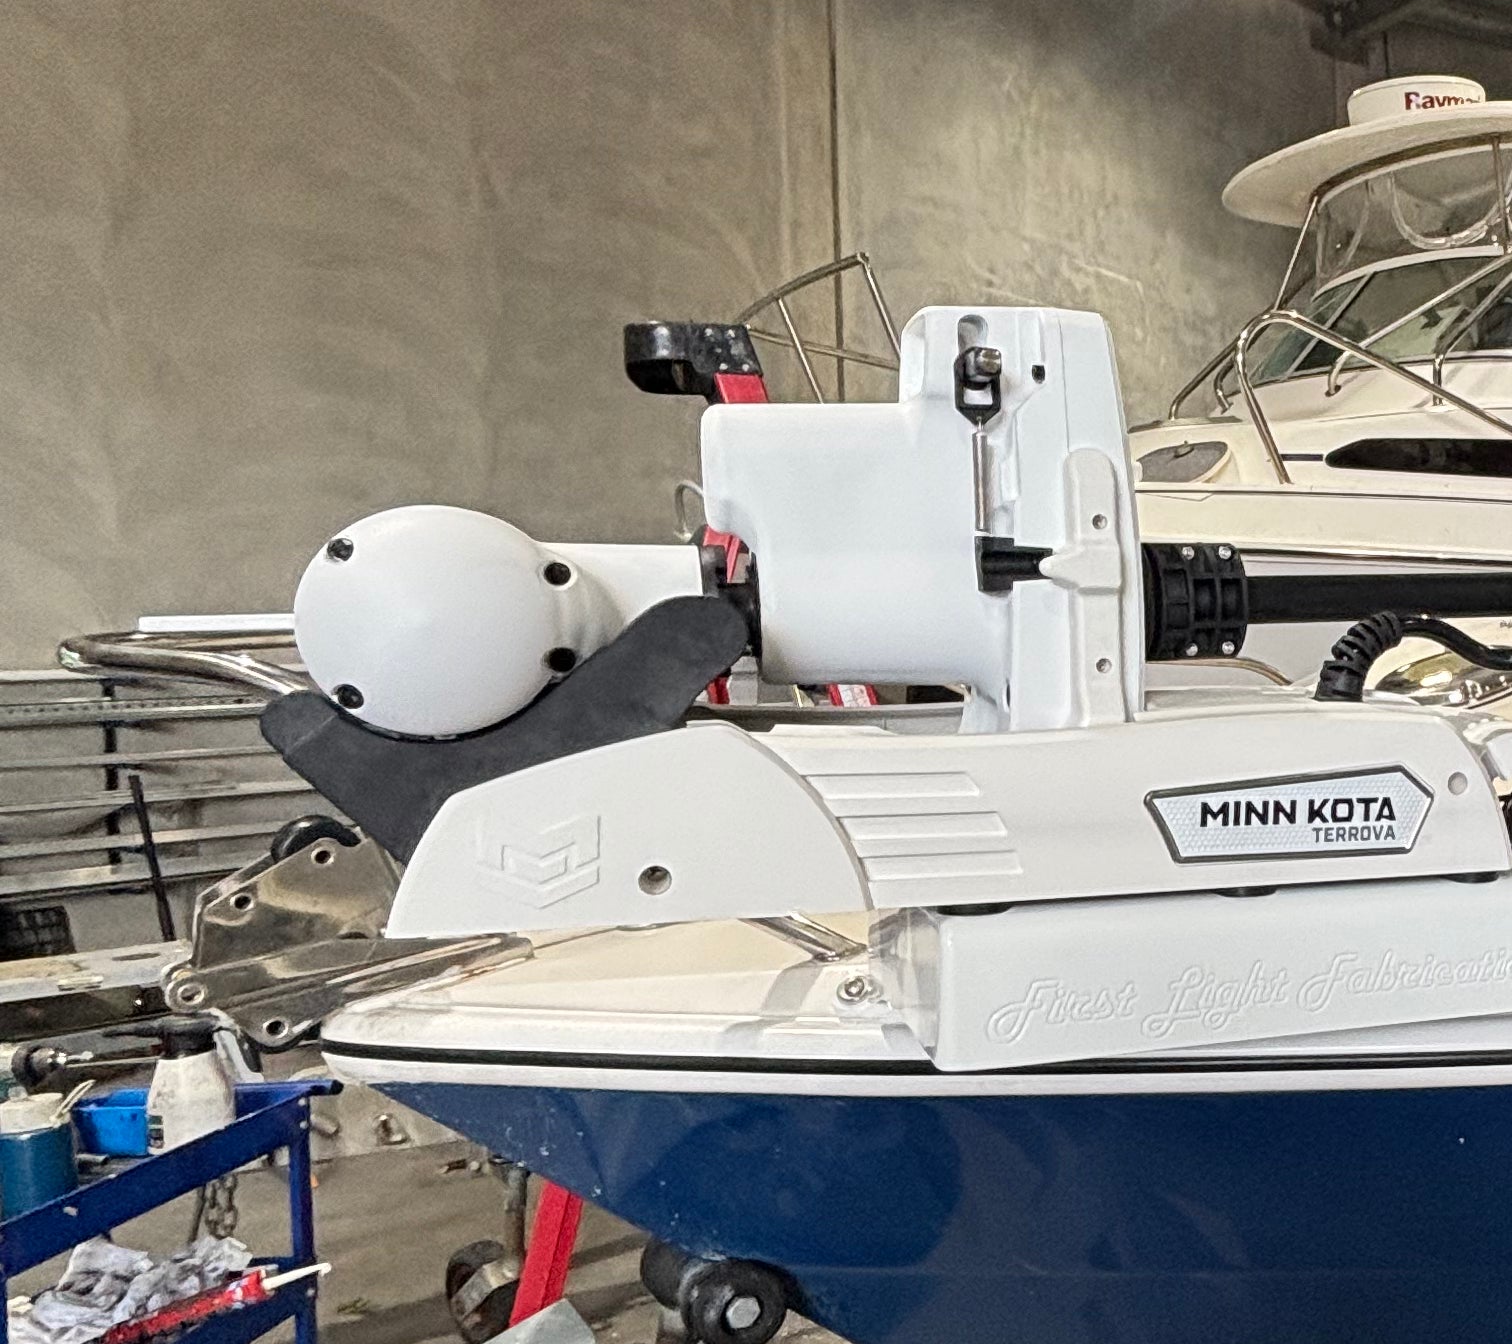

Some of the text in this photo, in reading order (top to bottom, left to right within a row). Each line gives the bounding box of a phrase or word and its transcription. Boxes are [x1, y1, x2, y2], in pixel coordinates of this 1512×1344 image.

[1199, 796, 1397, 828] MINN KOTA
[1311, 824, 1397, 844] TERROVA
[986, 977, 1138, 1045] First
[1140, 959, 1291, 1038] Light
